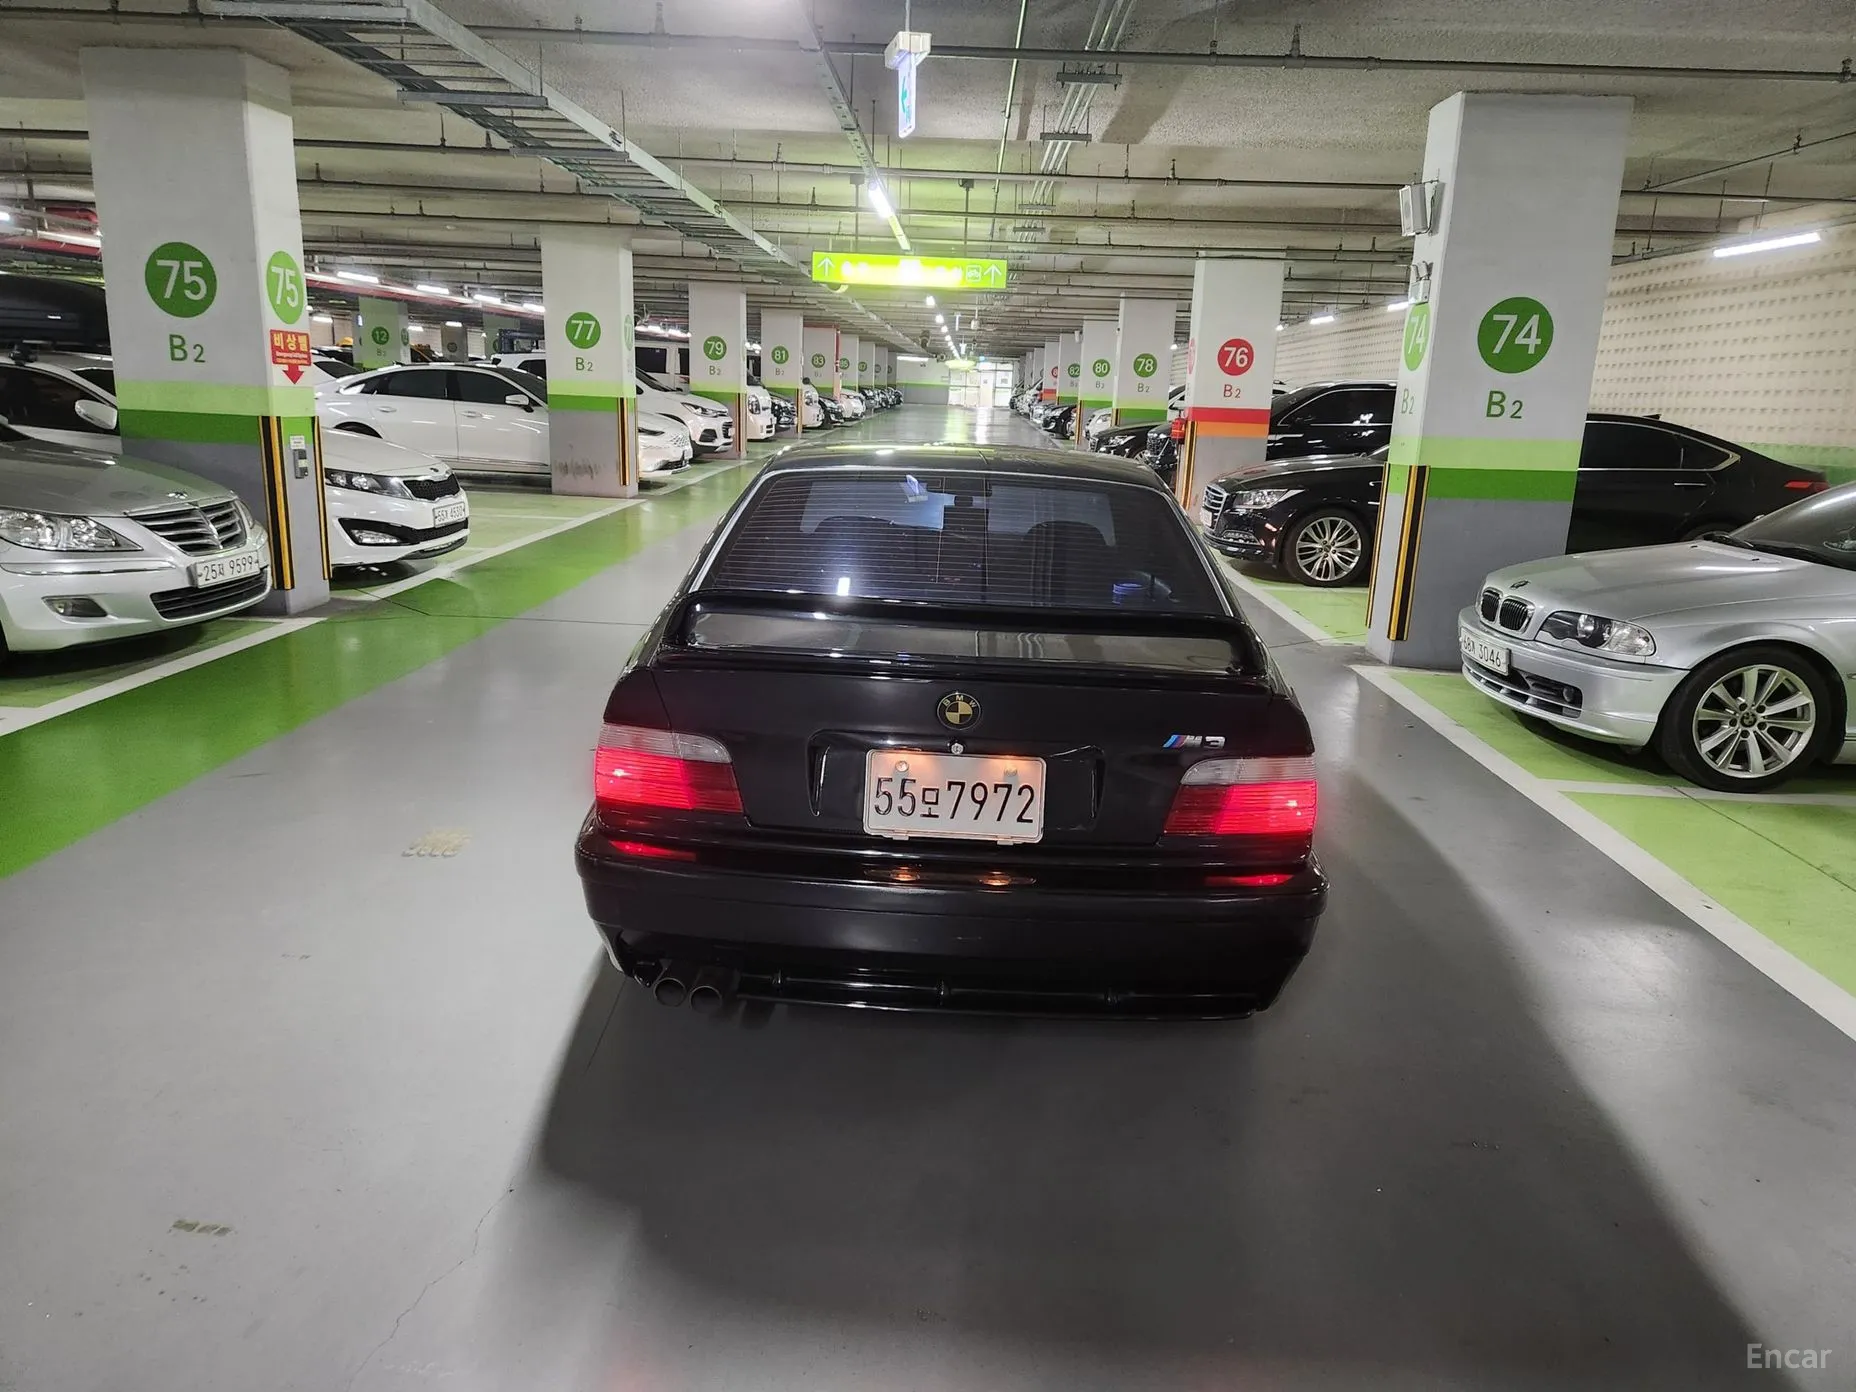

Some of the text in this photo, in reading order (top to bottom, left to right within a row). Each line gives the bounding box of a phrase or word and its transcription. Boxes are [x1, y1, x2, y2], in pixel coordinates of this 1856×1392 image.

[156, 259, 207, 301] 75
[271, 266, 299, 308] 75
[375, 330, 388, 342] 12
[571, 320, 596, 341] 77
[1408, 314, 1427, 355] 74
[1492, 314, 1542, 355] 74
[169, 334, 206, 363] B2
[707, 341, 724, 355] 79
[774, 350, 786, 361] 81
[1224, 346, 1248, 368] 76
[575, 357, 594, 372] B2
[813, 356, 824, 366] 83
[1095, 362, 1108, 373] 80
[1137, 358, 1154, 373] 78
[1223, 384, 1241, 399] B2
[1486, 390, 1524, 419] B2
[229, 555, 253, 575] 9599
[1479, 643, 1501, 667] 3046
[942, 694, 978, 707] BMW
[874, 777, 1036, 824] 55모7972
